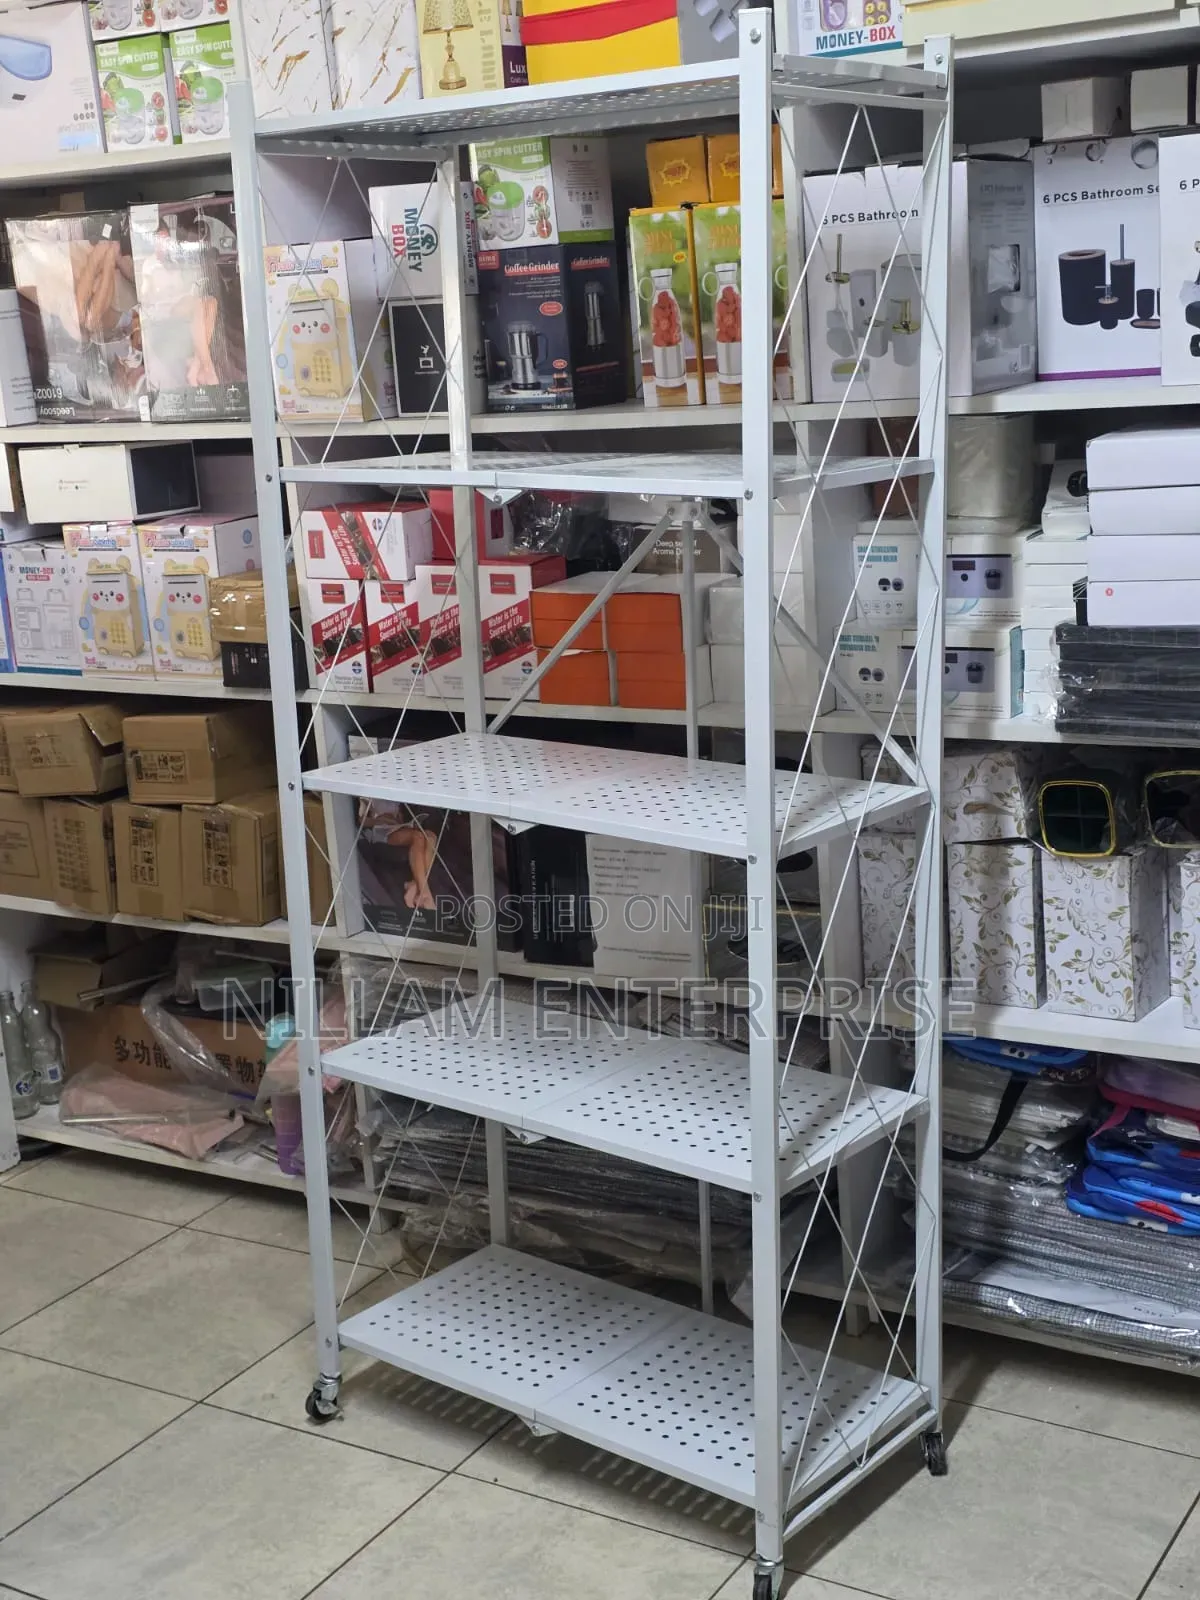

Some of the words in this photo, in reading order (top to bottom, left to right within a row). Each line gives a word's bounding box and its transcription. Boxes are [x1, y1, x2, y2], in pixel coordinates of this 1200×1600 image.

[816, 25, 896, 50] MONEY-BOX
[213, 40, 232, 51] CUTT
[1180, 180, 1187, 191] 6
[1043, 194, 1050, 204] 6
[1053, 192, 1078, 203] PCS
[1081, 186, 1144, 201] Bathroom
[1147, 184, 1160, 195] Se
[831, 213, 855, 225] PCS
[391, 224, 407, 258] BOX
[404, 208, 422, 273] MONEY
[504, 262, 528, 274] Coffee
[529, 260, 560, 272] Grinder
[34, 386, 63, 400] 61002
[321, 617, 334, 631] Water
[488, 614, 503, 628] Water
[510, 606, 519, 617] the
[379, 618, 393, 632] Water
[489, 624, 507, 639] Source
[513, 615, 523, 627] Life
[322, 626, 338, 640] Source
[380, 626, 396, 641] Source
